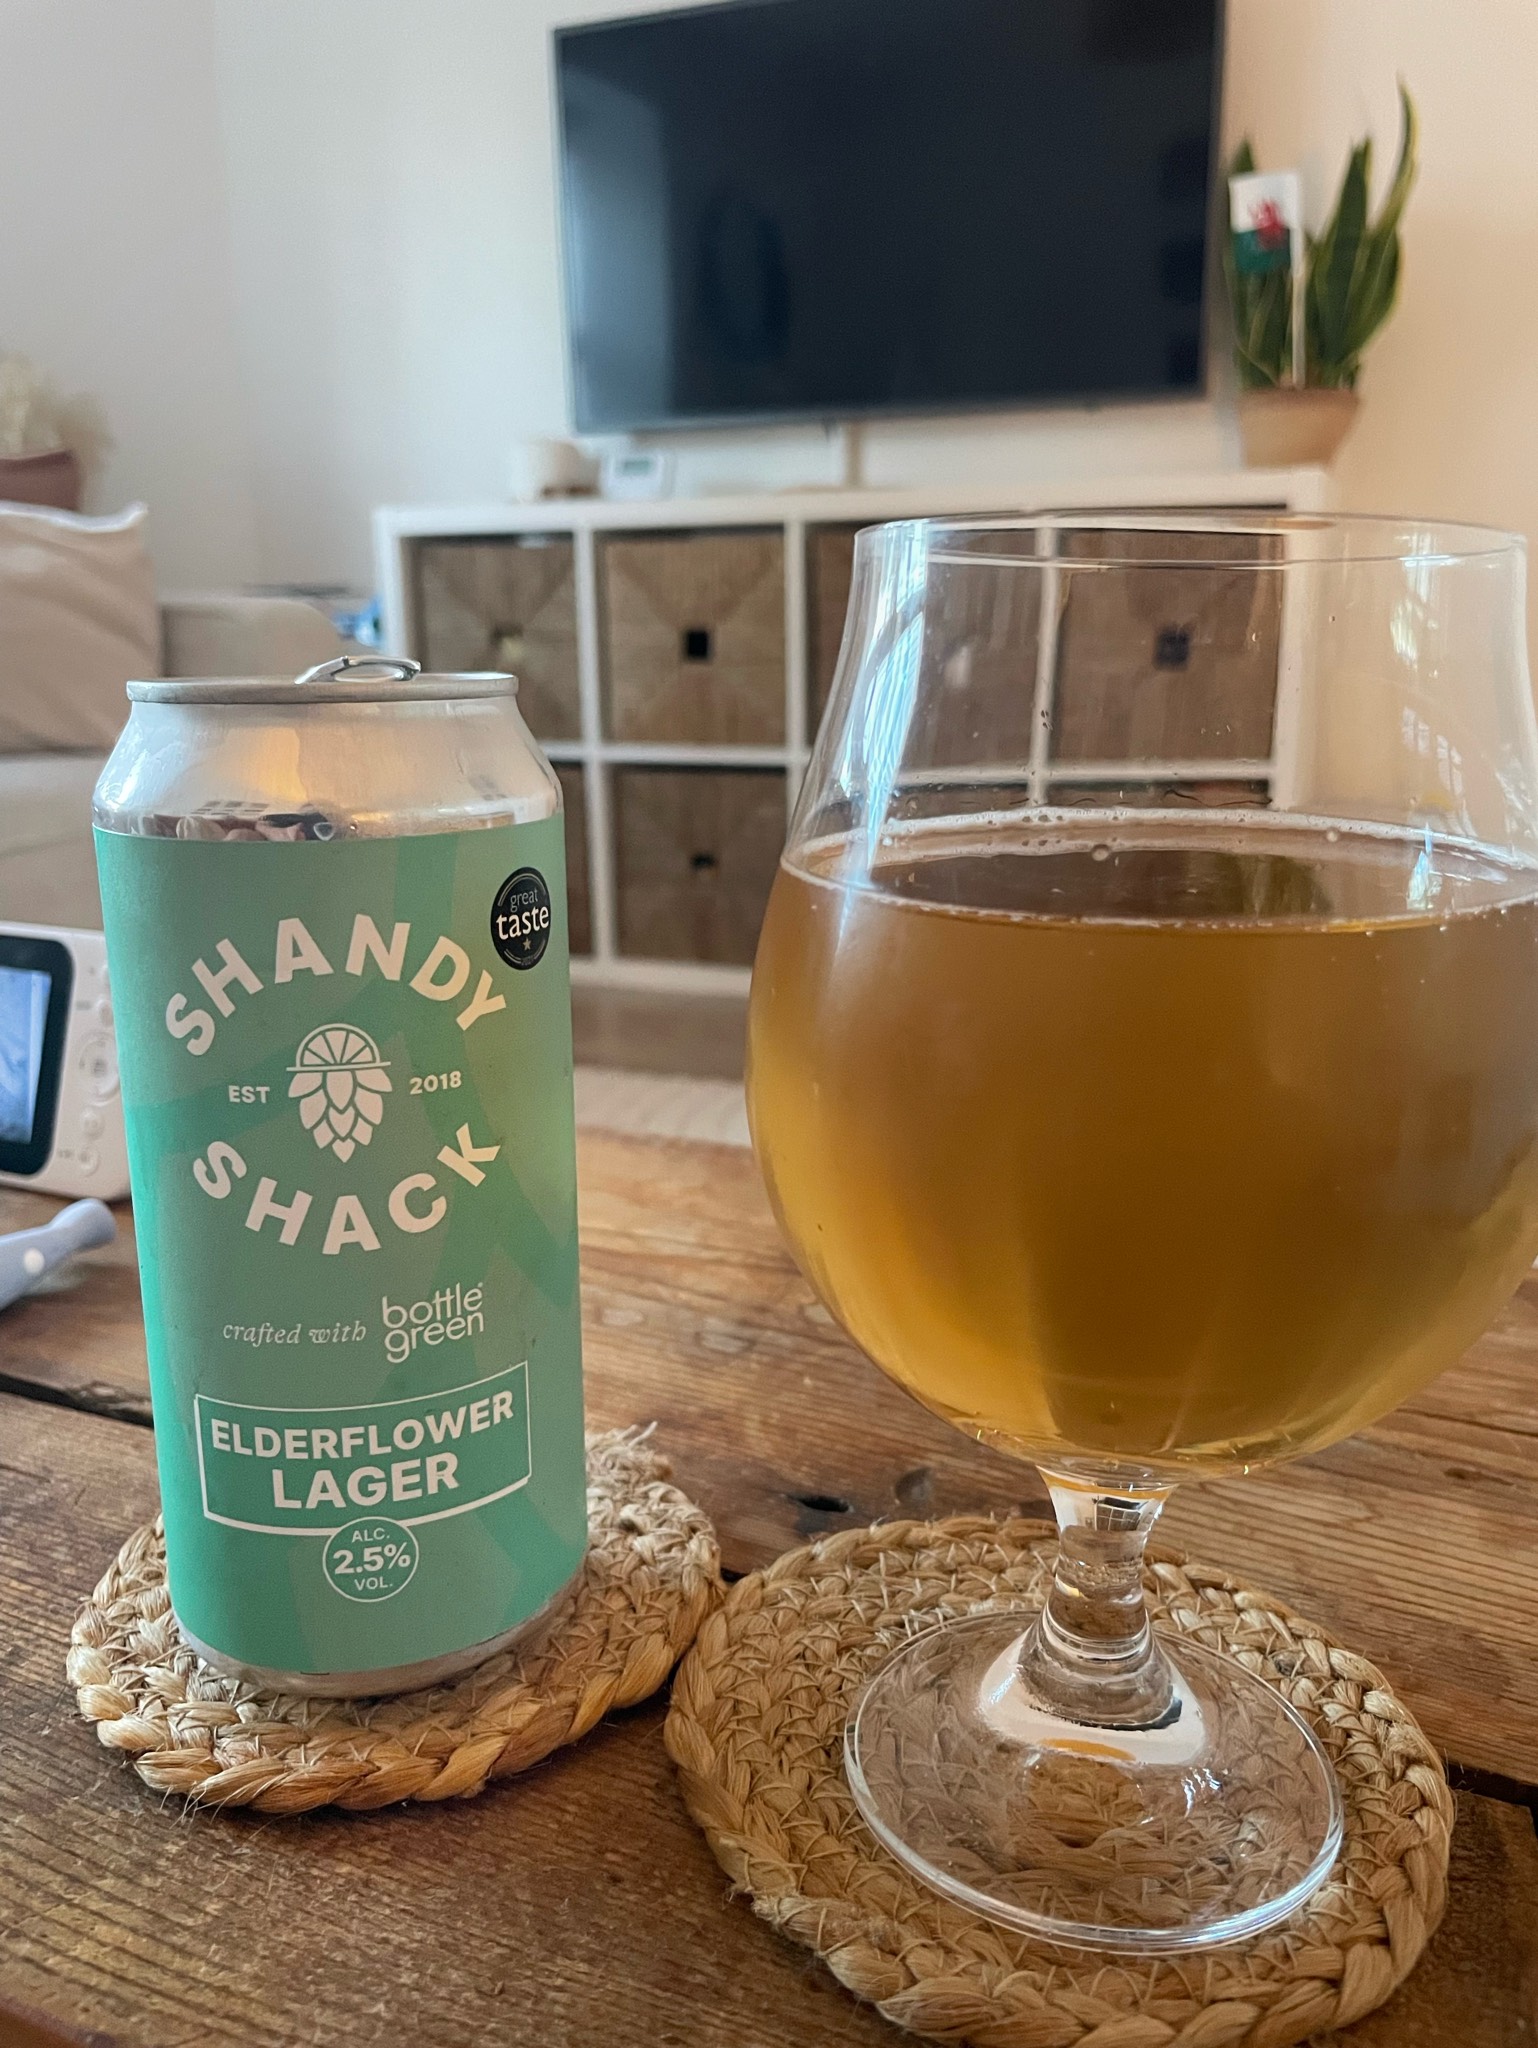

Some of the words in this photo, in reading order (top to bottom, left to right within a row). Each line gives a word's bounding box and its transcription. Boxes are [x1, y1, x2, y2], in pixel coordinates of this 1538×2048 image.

[510, 888, 539, 913] great
[496, 906, 549, 940] taste
[165, 914, 507, 1056] SHANDY
[228, 1085, 270, 1103] EST
[410, 1071, 462, 1095] 2018
[193, 1123, 501, 1255] SHACK
[382, 1282, 483, 1328] bottle
[223, 1323, 301, 1347] crafted
[308, 1320, 367, 1344] with
[384, 1312, 484, 1363] green
[211, 1390, 514, 1459] ELDERFLOWER
[272, 1452, 459, 1509] LAGER
[351, 1527, 390, 1543] ALC.
[333, 1541, 411, 1575] 2.5%
[354, 1576, 393, 1591] VOL.
